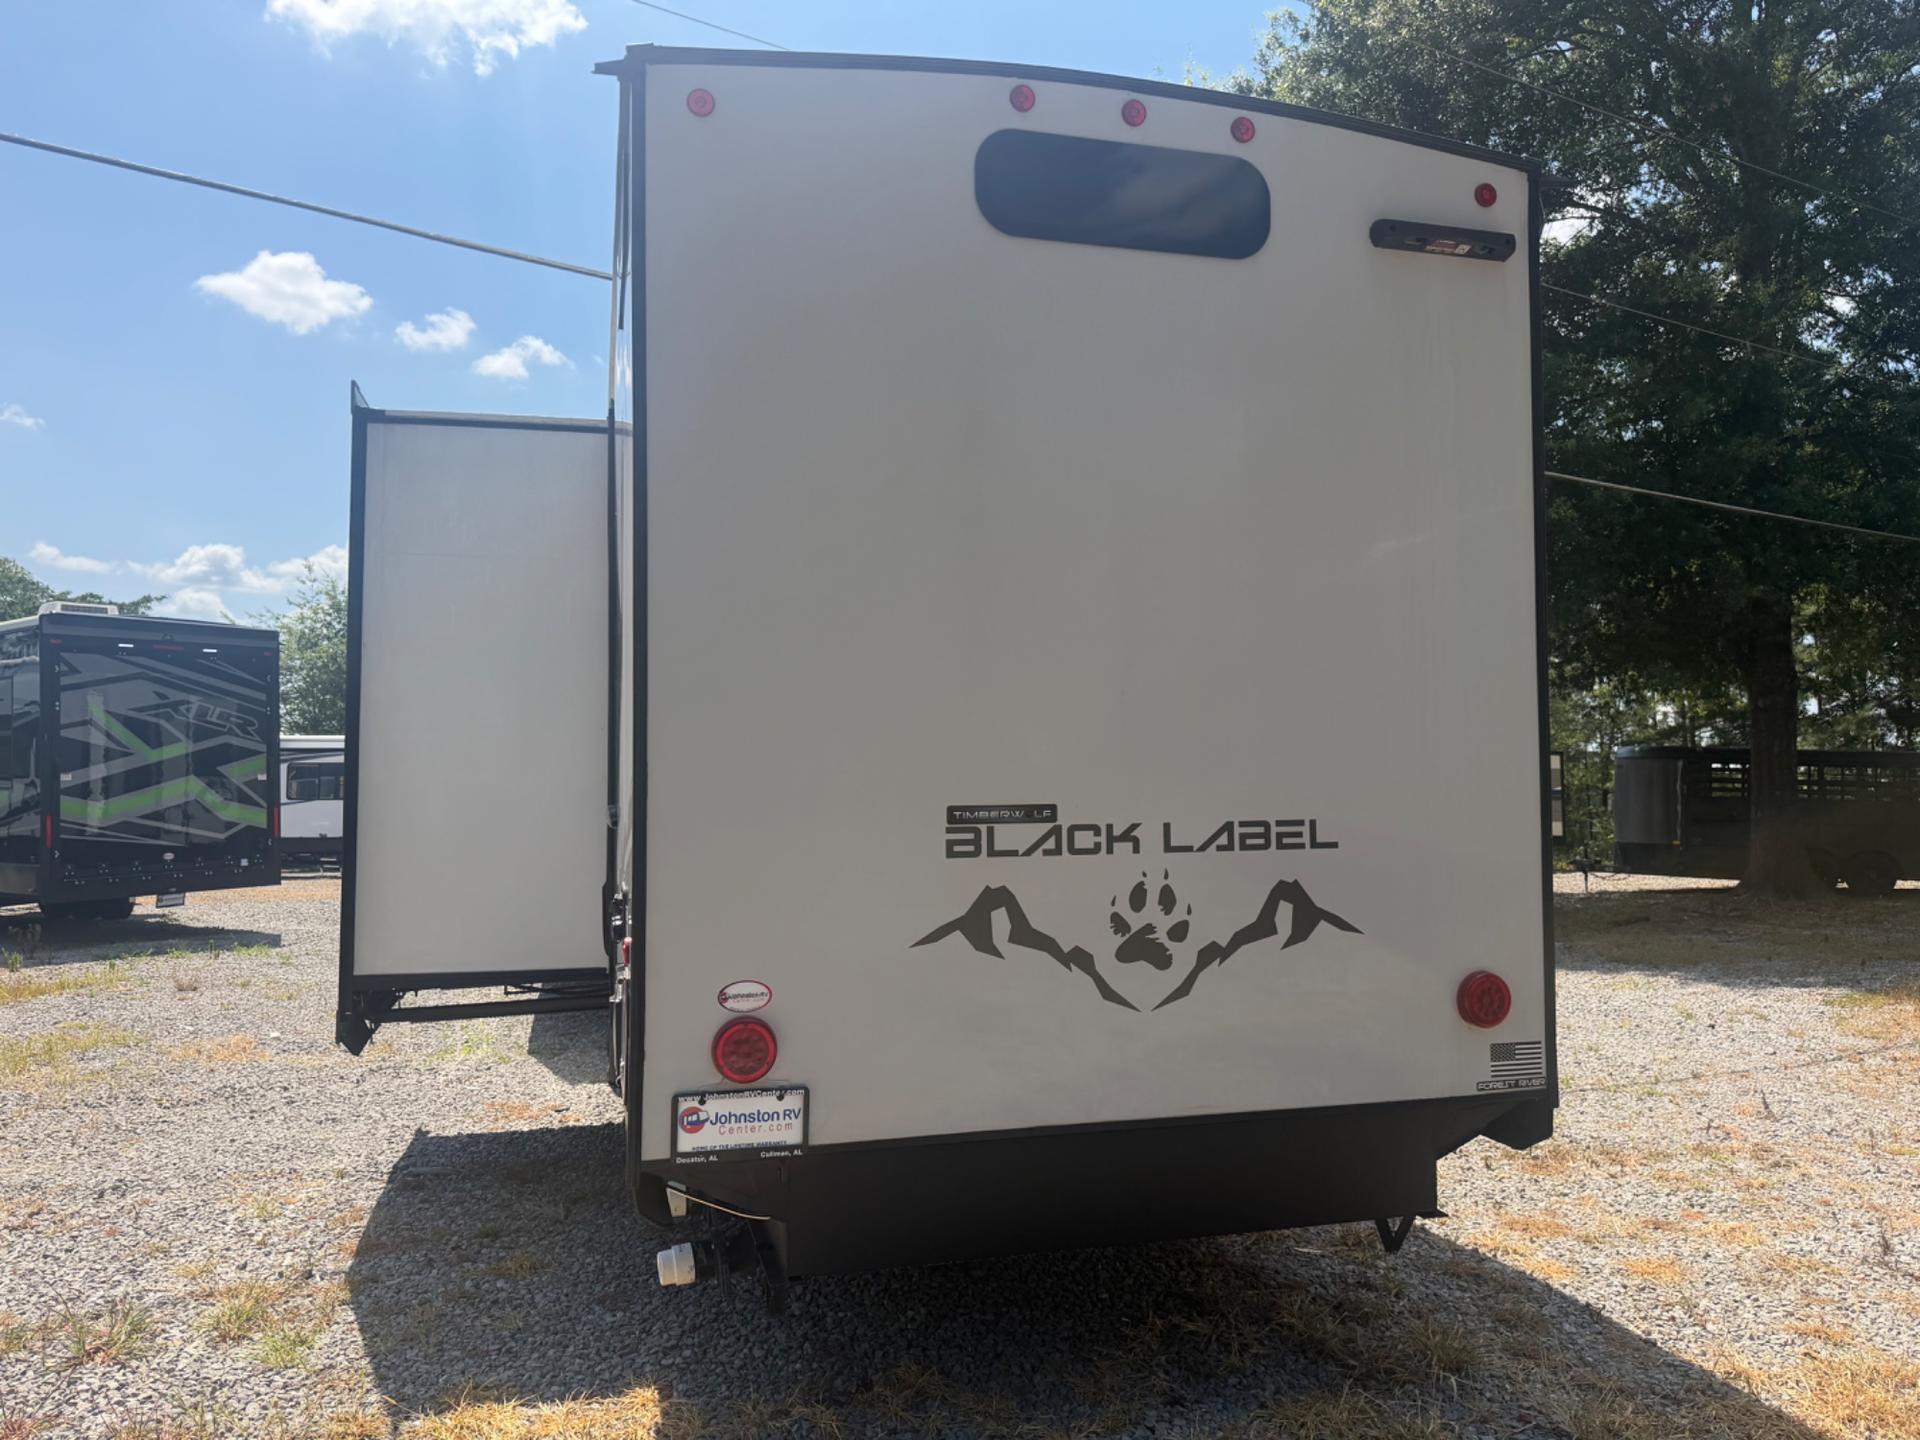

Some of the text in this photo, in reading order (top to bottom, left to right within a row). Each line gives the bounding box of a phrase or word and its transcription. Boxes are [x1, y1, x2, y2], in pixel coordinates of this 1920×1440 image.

[953, 809, 1052, 820] TIMBERWLF
[945, 818, 1339, 859] BLACK LABEL
[709, 1107, 802, 1126] Johnston RV
[718, 1122, 793, 1136] Center.com
[793, 1148, 803, 1156] AL
